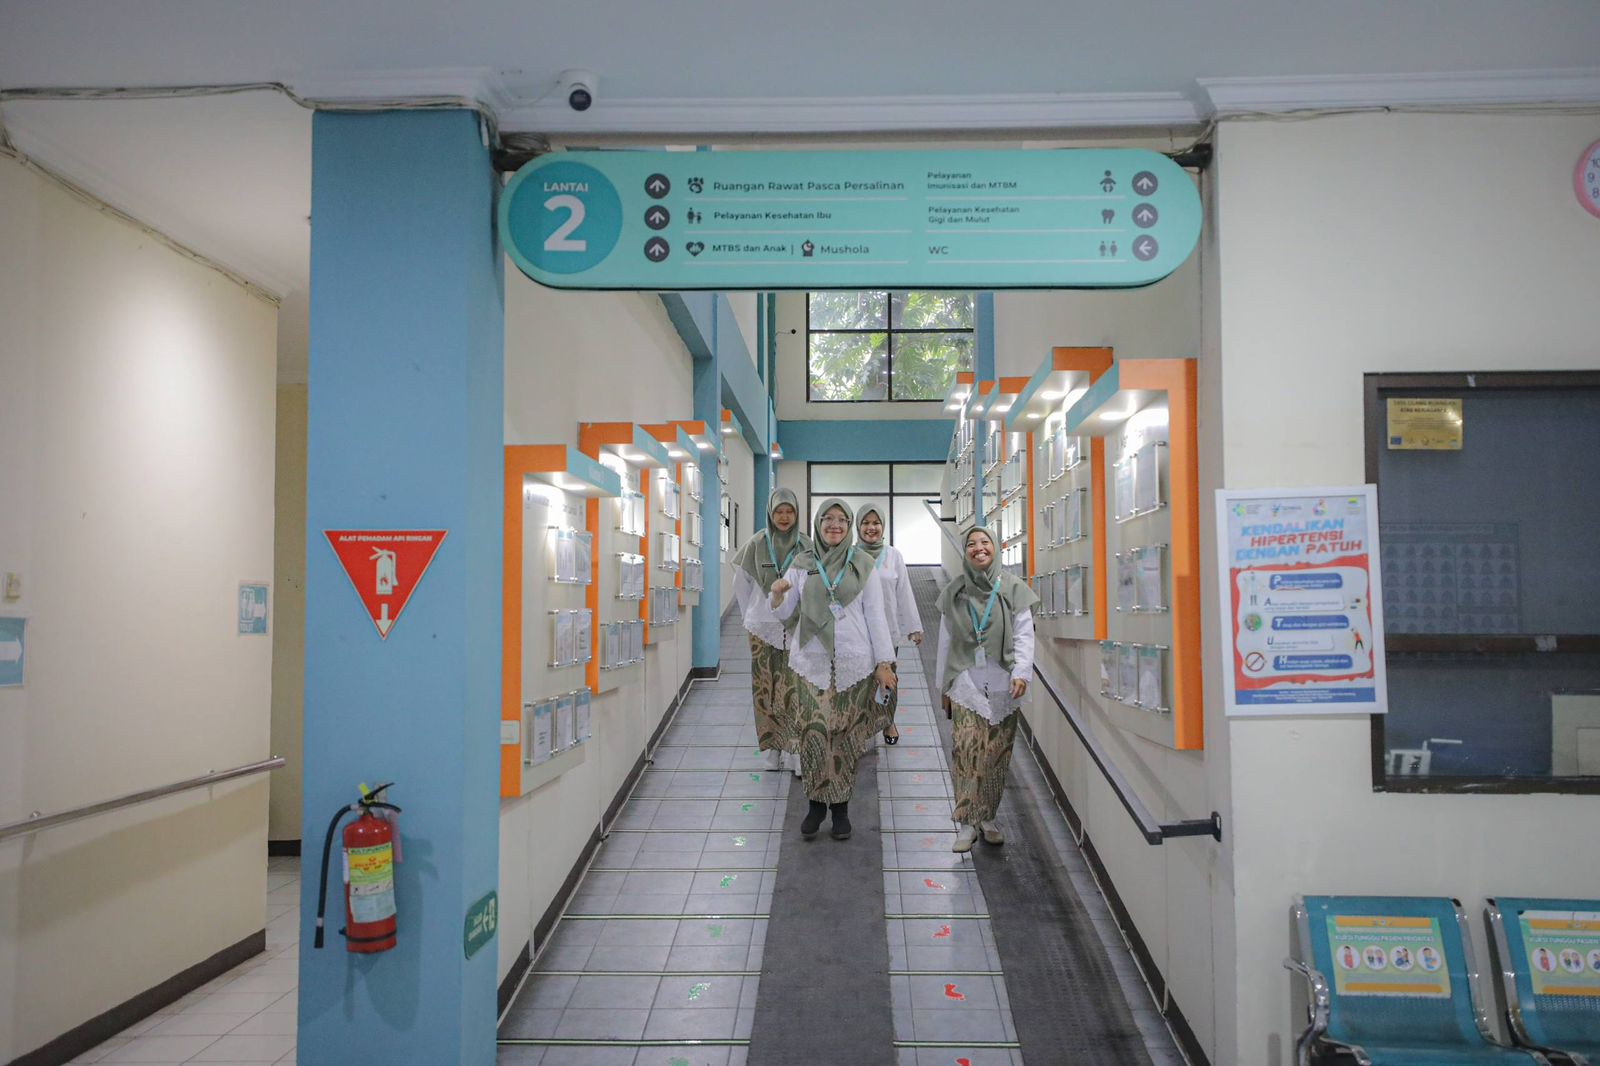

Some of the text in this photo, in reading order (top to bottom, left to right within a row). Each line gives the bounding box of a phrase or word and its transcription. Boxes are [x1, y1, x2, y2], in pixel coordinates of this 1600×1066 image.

[927, 171, 972, 180] Pelayanan
[1587, 172, 1595, 183] 9
[543, 182, 589, 193] LANTAI
[713, 180, 905, 193] Ruangan Rawat Pasca Persalinan
[927, 181, 1017, 190] Imunisasi dan MTBM
[1592, 187, 1600, 198] 8
[928, 206, 1020, 215] Pelayanan Kesehatan
[713, 211, 832, 221] Pelayanan Kesehatan Ibu
[928, 216, 990, 225] Gigi dan Mulut
[543, 194, 587, 252] 2
[712, 243, 787, 253] MTBS dan Anak
[820, 244, 870, 254] Mushola
[928, 245, 949, 255] WC
[1240, 518, 1345, 537] KENDALIKAN
[1250, 530, 1344, 547] HIPERTENSI
[1235, 540, 1363, 561] DENGAN PATUH
